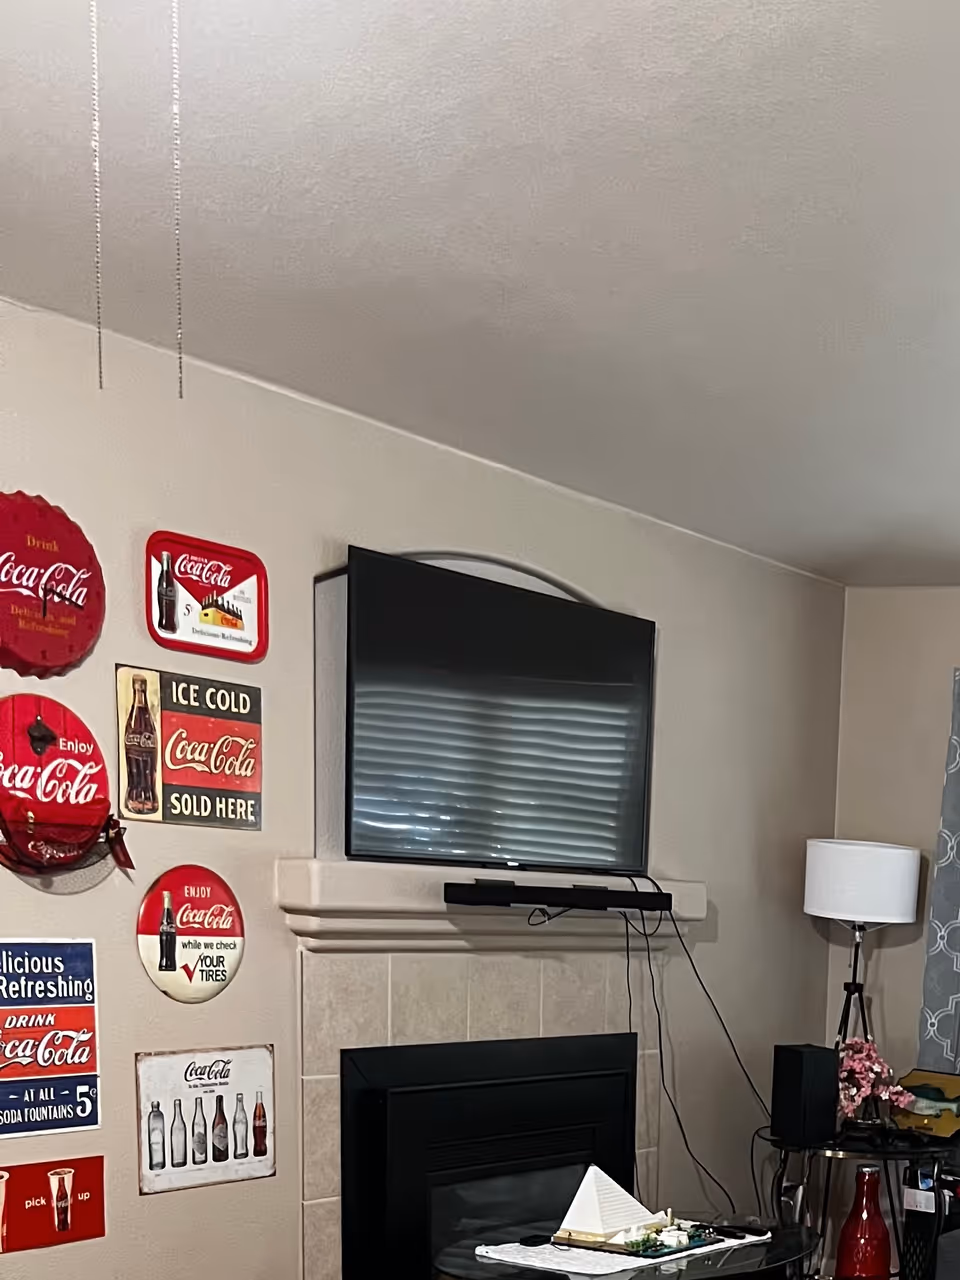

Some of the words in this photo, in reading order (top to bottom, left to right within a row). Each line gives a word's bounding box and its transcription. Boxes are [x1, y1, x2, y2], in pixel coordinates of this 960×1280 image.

[27, 534, 59, 552] Drink
[174, 553, 233, 588] Coca-Cola
[172, 681, 199, 706] ICE
[206, 688, 251, 714] COLD
[59, 738, 94, 756] Enjoy
[165, 729, 256, 777] Coca-Cola
[170, 793, 211, 817] SOLD
[216, 797, 256, 823] HERE
[184, 886, 211, 898] ENJOY
[176, 903, 234, 929] Coca-Cola
[182, 940, 201, 950] while
[216, 940, 237, 950] check
[0, 950, 64, 973] licious
[199, 954, 225, 968] YOUR
[199, 969, 227, 982] TIRES
[5, 1014, 56, 1029] DRINK
[184, 1059, 233, 1082] Coca-Cola
[24, 1089, 35, 1102] AT
[40, 1088, 55, 1100] ALL
[25, 1104, 74, 1122] FOUNTAINS
[25, 1197, 47, 1210] pick
[78, 1192, 90, 1201] up
